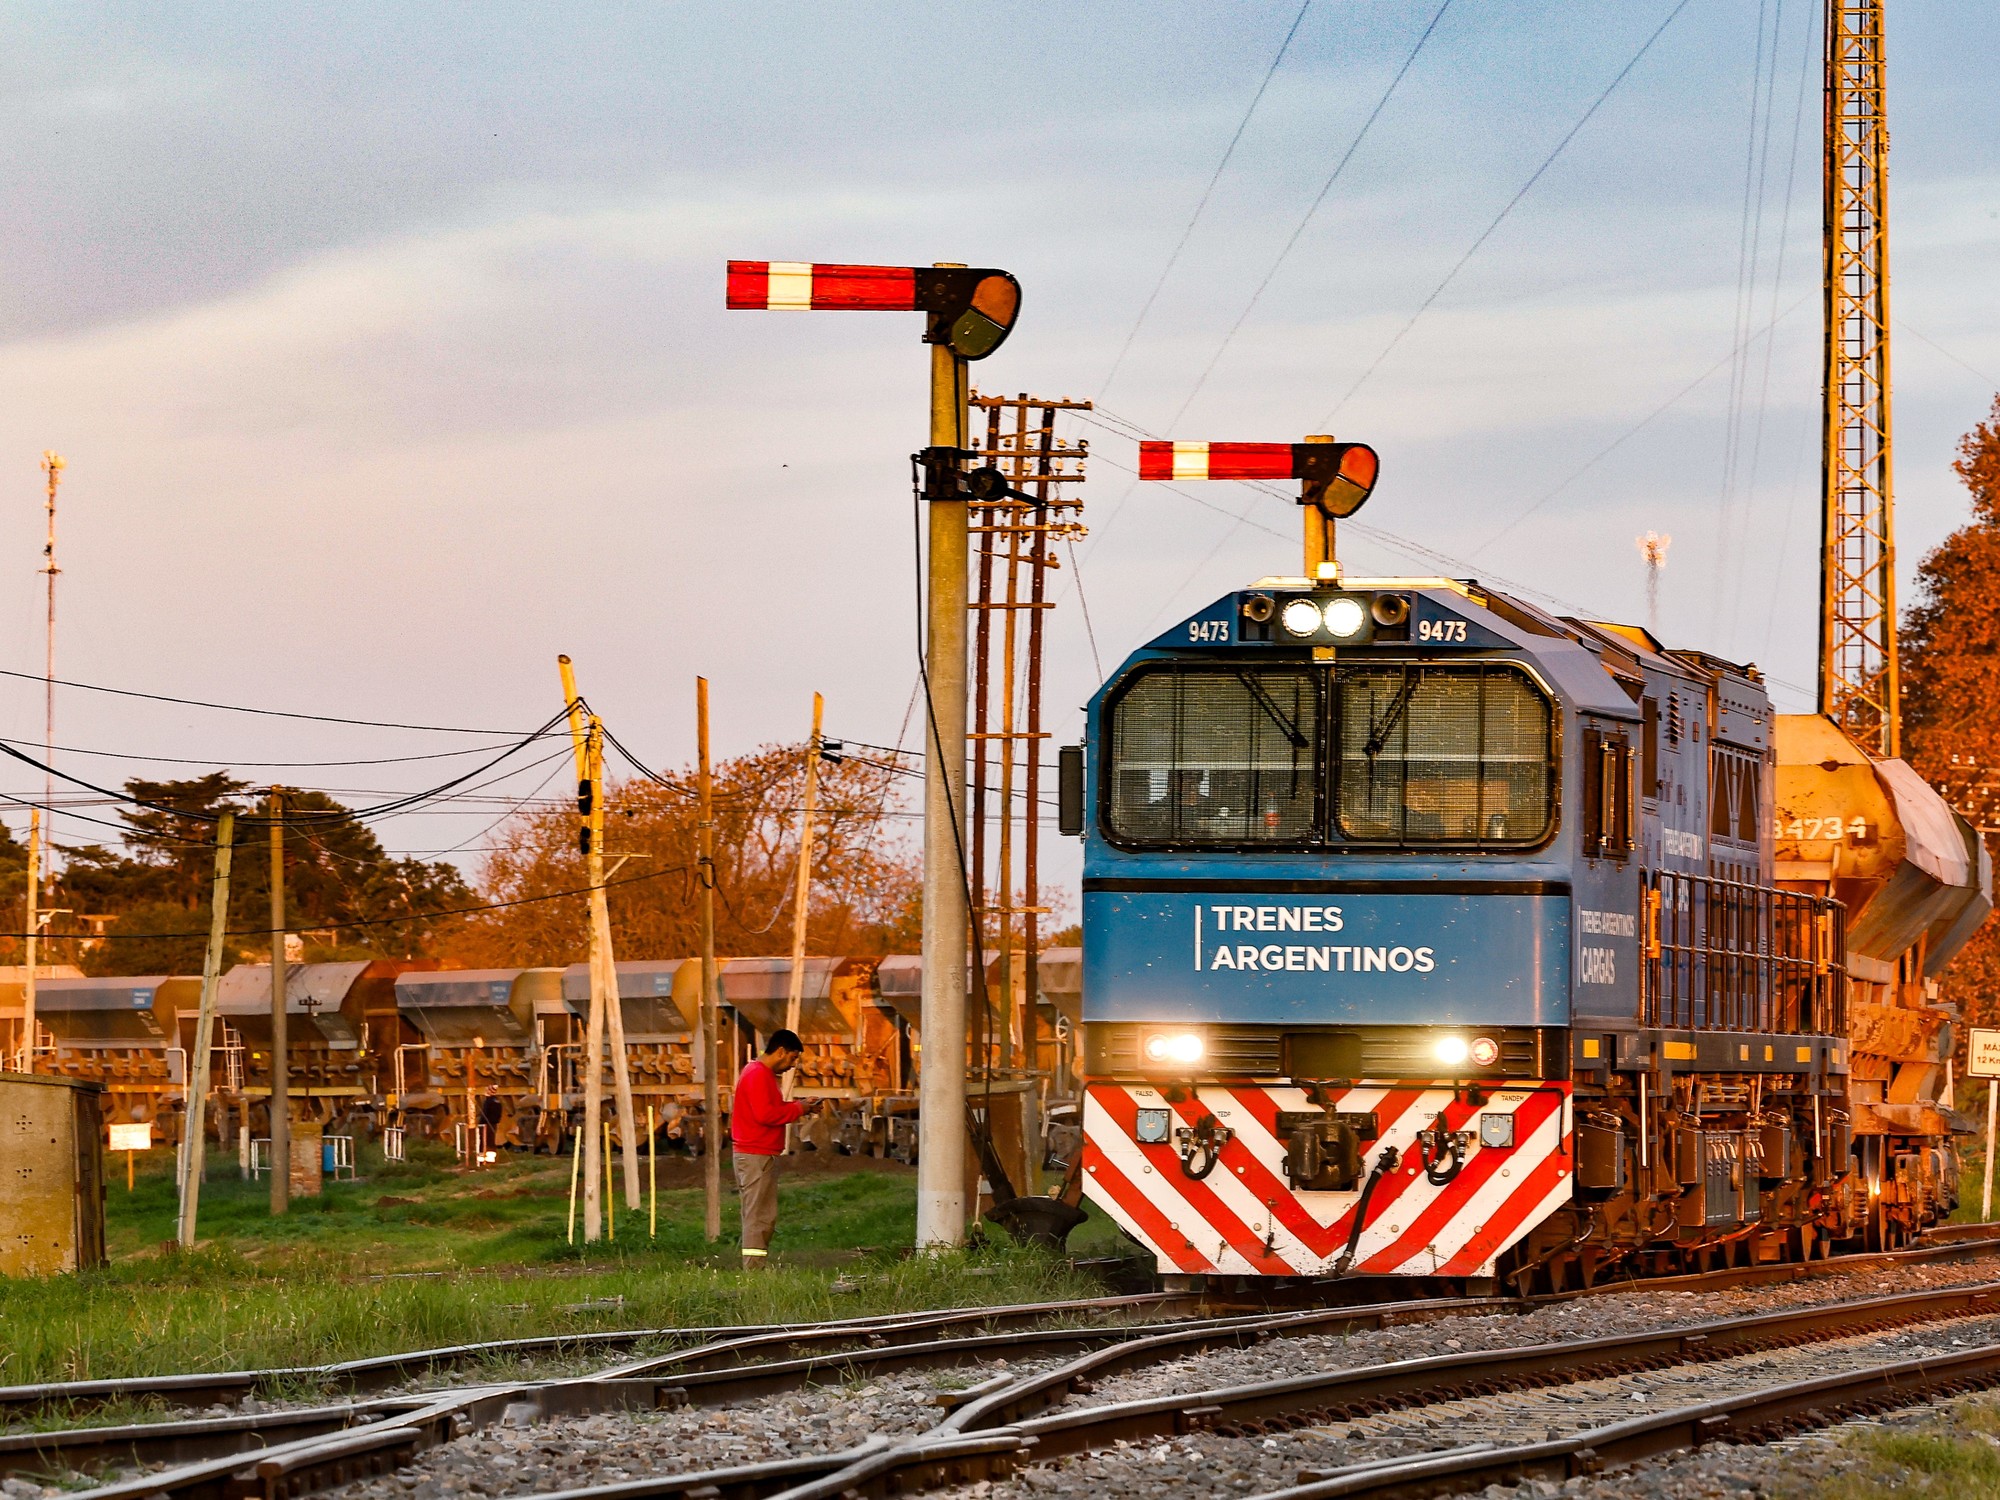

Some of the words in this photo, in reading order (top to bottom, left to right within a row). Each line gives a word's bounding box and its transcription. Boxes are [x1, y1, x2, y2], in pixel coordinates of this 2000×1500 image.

[1188, 620, 1229, 642] 9473
[1418, 620, 1467, 642] 9473
[1211, 905, 1344, 932] TRENES
[1581, 910, 1602, 933] TRENES
[1210, 945, 1436, 973] ARGENTINOS
[1582, 946, 1616, 985] CARGAS
[1977, 1055, 1987, 1064] 12
[1501, 1094, 1525, 1102] TANDEM
